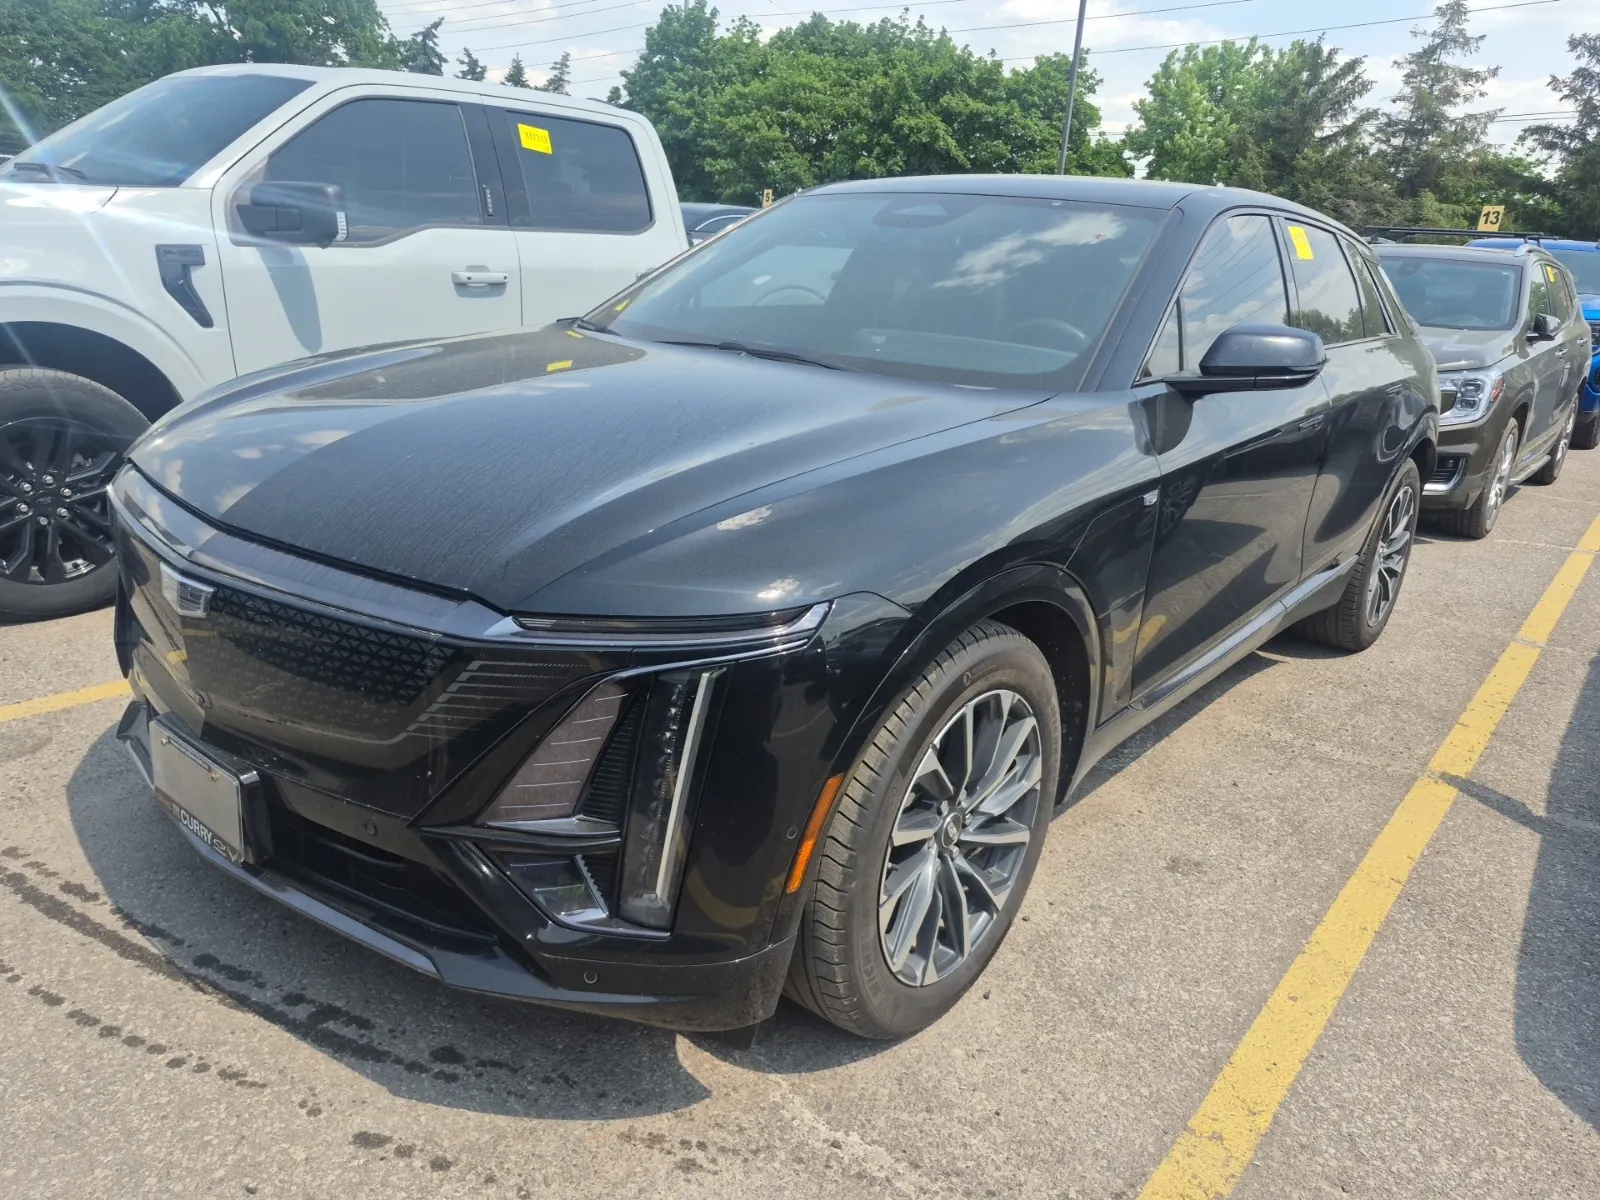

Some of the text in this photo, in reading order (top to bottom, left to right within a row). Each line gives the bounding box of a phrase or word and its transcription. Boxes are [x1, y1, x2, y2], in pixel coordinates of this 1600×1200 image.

[765, 192, 771, 203] 5
[1482, 210, 1501, 225] 13
[181, 809, 212, 845] CURRY
